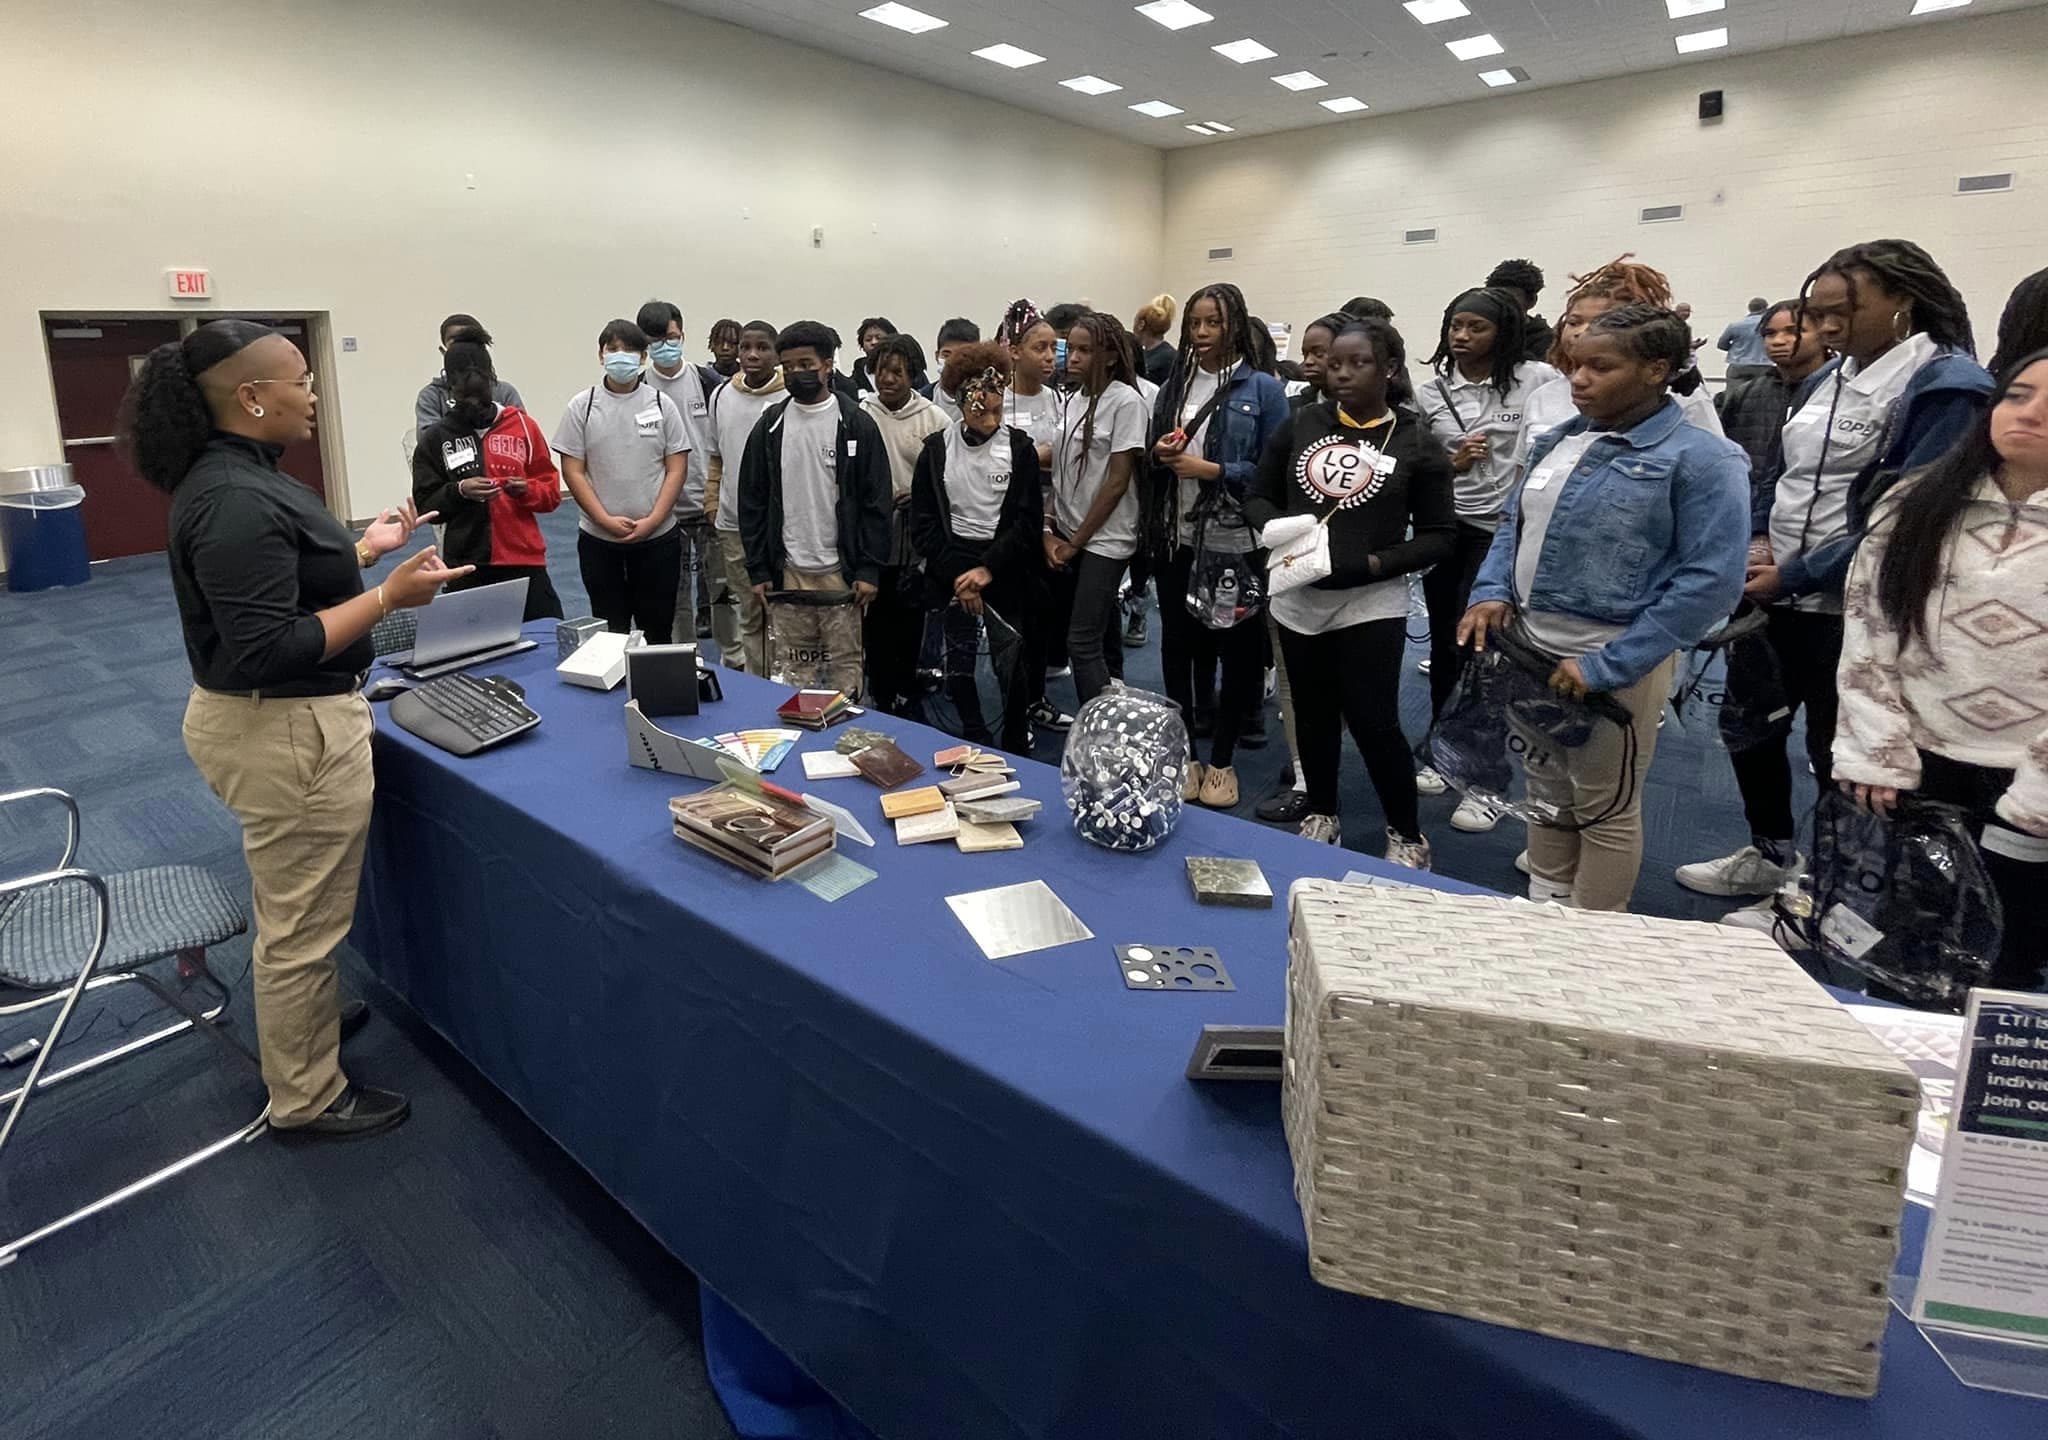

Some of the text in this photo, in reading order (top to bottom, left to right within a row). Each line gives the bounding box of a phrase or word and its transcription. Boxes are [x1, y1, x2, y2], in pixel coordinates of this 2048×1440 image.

[176, 273, 206, 293] EXIT
[639, 421, 660, 430] OPE
[1491, 413, 1523, 423] OP
[1833, 418, 1872, 437] OPE
[1324, 450, 1360, 470] LO
[1322, 466, 1356, 490] VE
[788, 647, 832, 662] HOPE
[1994, 1033, 2028, 1047] the
[1982, 1092, 2021, 1108] join
